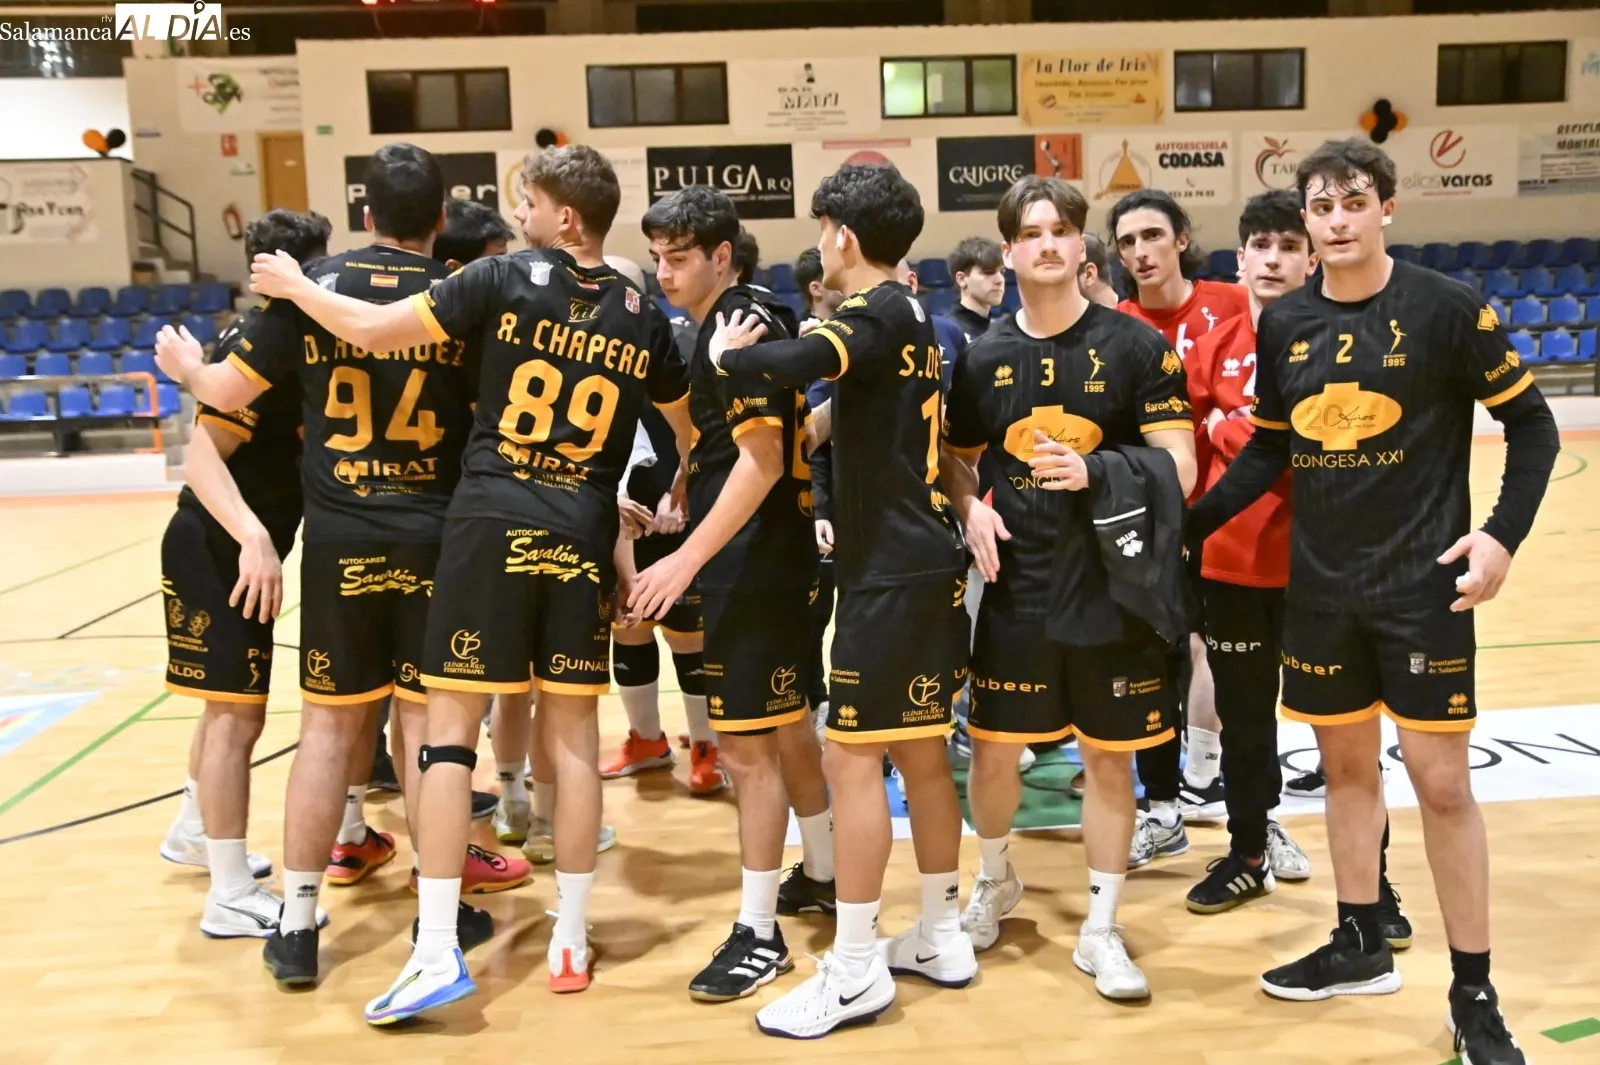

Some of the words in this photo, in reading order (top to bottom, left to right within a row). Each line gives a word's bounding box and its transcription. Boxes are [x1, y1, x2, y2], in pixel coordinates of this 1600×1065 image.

[1096, 57, 1115, 72] de
[1155, 141, 1229, 151] AUTOESCUELA
[1158, 152, 1225, 169] CODASA
[303, 334, 328, 365] D.
[532, 318, 650, 380] CHAPERO
[1336, 333, 1355, 364] 2
[1382, 357, 1406, 367] 1995
[1040, 358, 1055, 387] 3
[1084, 384, 1105, 393] 1995
[323, 365, 446, 452] 94
[498, 358, 620, 463] 89
[1305, 403, 1344, 431] 20
[335, 456, 439, 484] MIRAT
[1291, 453, 1371, 469] CONGESA
[1375, 449, 1404, 467] XXI
